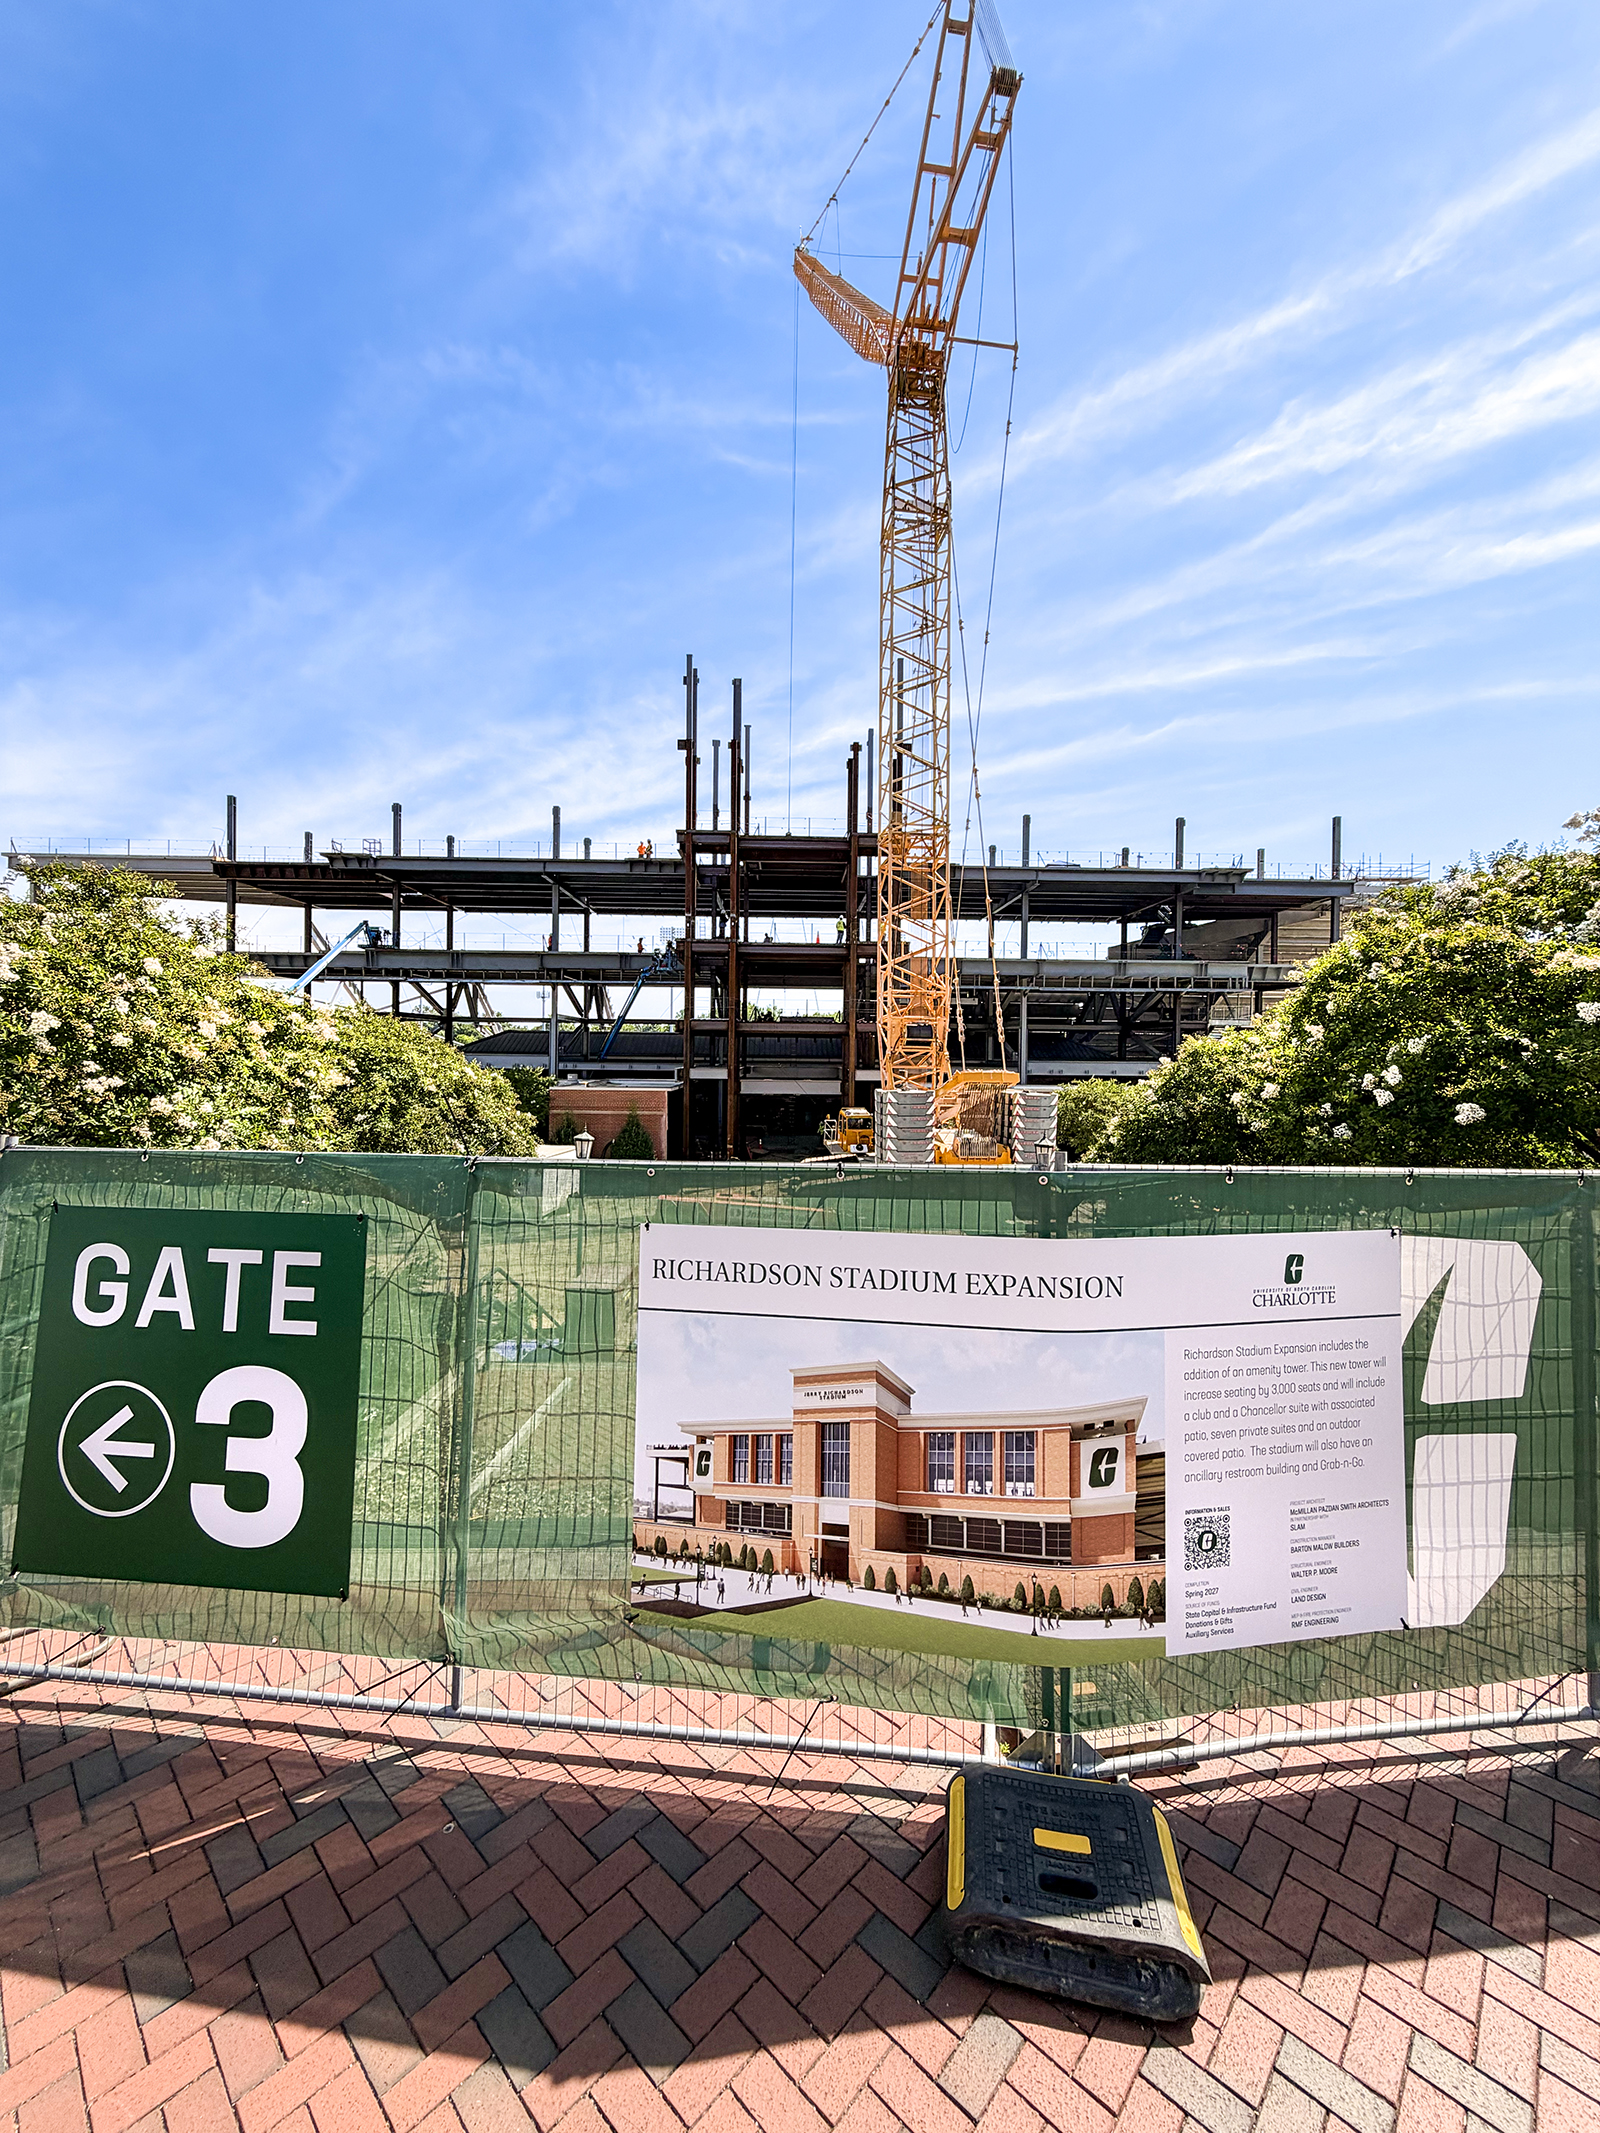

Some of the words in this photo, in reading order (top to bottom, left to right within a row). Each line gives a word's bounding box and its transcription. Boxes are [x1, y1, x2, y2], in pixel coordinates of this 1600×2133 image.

[652, 1258, 823, 1287] RICHARDSON
[829, 1266, 958, 1295] STADIUM
[966, 1272, 1124, 1299] EXPANSION
[72, 1242, 321, 1336] GATE
[1252, 1291, 1336, 1308] CHARLOTTE
[1183, 1346, 1234, 1360] Richardson
[1235, 1344, 1272, 1358] Stadium
[1273, 1342, 1317, 1357] Expansion
[1318, 1339, 1354, 1352] includes
[1354, 1337, 1369, 1350] the
[1183, 1368, 1220, 1381] addition
[1221, 1365, 1231, 1379] of
[1232, 1368, 1244, 1378] an
[1245, 1364, 1282, 1378] amenity
[1283, 1363, 1309, 1374] tower.
[1310, 1360, 1328, 1372] This
[1329, 1361, 1348, 1371] new
[1348, 1359, 1372, 1370] tower
[1372, 1356, 1387, 1368] will
[824, 1388, 864, 1396] RICHARDSON
[1184, 1390, 1222, 1401] increase
[1223, 1386, 1256, 1400] seating
[1258, 1384, 1270, 1399] by
[1297, 1382, 1321, 1393] seats
[1322, 1378, 1339, 1392] and
[1340, 1377, 1354, 1390] will
[1355, 1375, 1386, 1389] include
[1183, 1412, 1190, 1422] a
[1191, 1408, 1212, 1421] club
[1213, 1406, 1231, 1420] and
[1232, 1409, 1239, 1418] a
[1240, 1403, 1287, 1418] Chancellor
[1288, 1402, 1310, 1414] suite
[1310, 1399, 1329, 1412] with
[1330, 1395, 1376, 1411] associated
[1184, 1429, 1209, 1445] patio,
[1210, 1429, 1237, 1440] seven
[1238, 1425, 1269, 1440] private
[1270, 1423, 1297, 1435] suites
[1297, 1419, 1315, 1433] and
[1316, 1421, 1328, 1432] an
[1329, 1417, 1361, 1431] outdoor
[190, 1365, 309, 1548] 3
[1184, 1447, 1220, 1463] covered
[1222, 1447, 1246, 1462] patio.
[1249, 1444, 1267, 1457] The
[1268, 1442, 1304, 1456] stadium
[1304, 1439, 1319, 1452] will
[1320, 1438, 1339, 1451] also
[1339, 1437, 1361, 1449] have
[1361, 1437, 1373, 1448] an
[1184, 1469, 1223, 1483] ancillary
[1224, 1467, 1264, 1479] restroom
[1266, 1462, 1300, 1477] building
[1301, 1459, 1319, 1473] and
[1320, 1456, 1365, 1471] Grab-n-Go.
[1289, 1506, 1318, 1516] McMILLAN
[1318, 1504, 1340, 1513] PAZDAN
[1340, 1502, 1357, 1511] SMITH
[1357, 1499, 1390, 1509] ARCHITECTS
[1289, 1523, 1306, 1532] SLAM
[1290, 1544, 1313, 1554] BARTON
[1312, 1542, 1334, 1551] MALOW
[1333, 1539, 1360, 1550] BUILDERS
[1290, 1569, 1313, 1578] WALTER
[1318, 1566, 1338, 1575] MOORE
[1184, 1590, 1204, 1599] Spring
[1204, 1587, 1219, 1596] 2027
[1290, 1595, 1306, 1604] LAND
[1306, 1593, 1327, 1602] DESIGN
[1185, 1611, 1201, 1620] State
[1200, 1607, 1221, 1618] Capital
[1226, 1604, 1263, 1614] Infrastructure
[1263, 1601, 1277, 1610] Fund
[1185, 1620, 1214, 1630] Donations
[1219, 1616, 1233, 1626] Gifts
[1291, 1620, 1303, 1629] RMF
[1304, 1615, 1340, 1628] ENGINEERING
[1185, 1630, 1210, 1639] Auxiliary
[1210, 1627, 1235, 1637] Services
